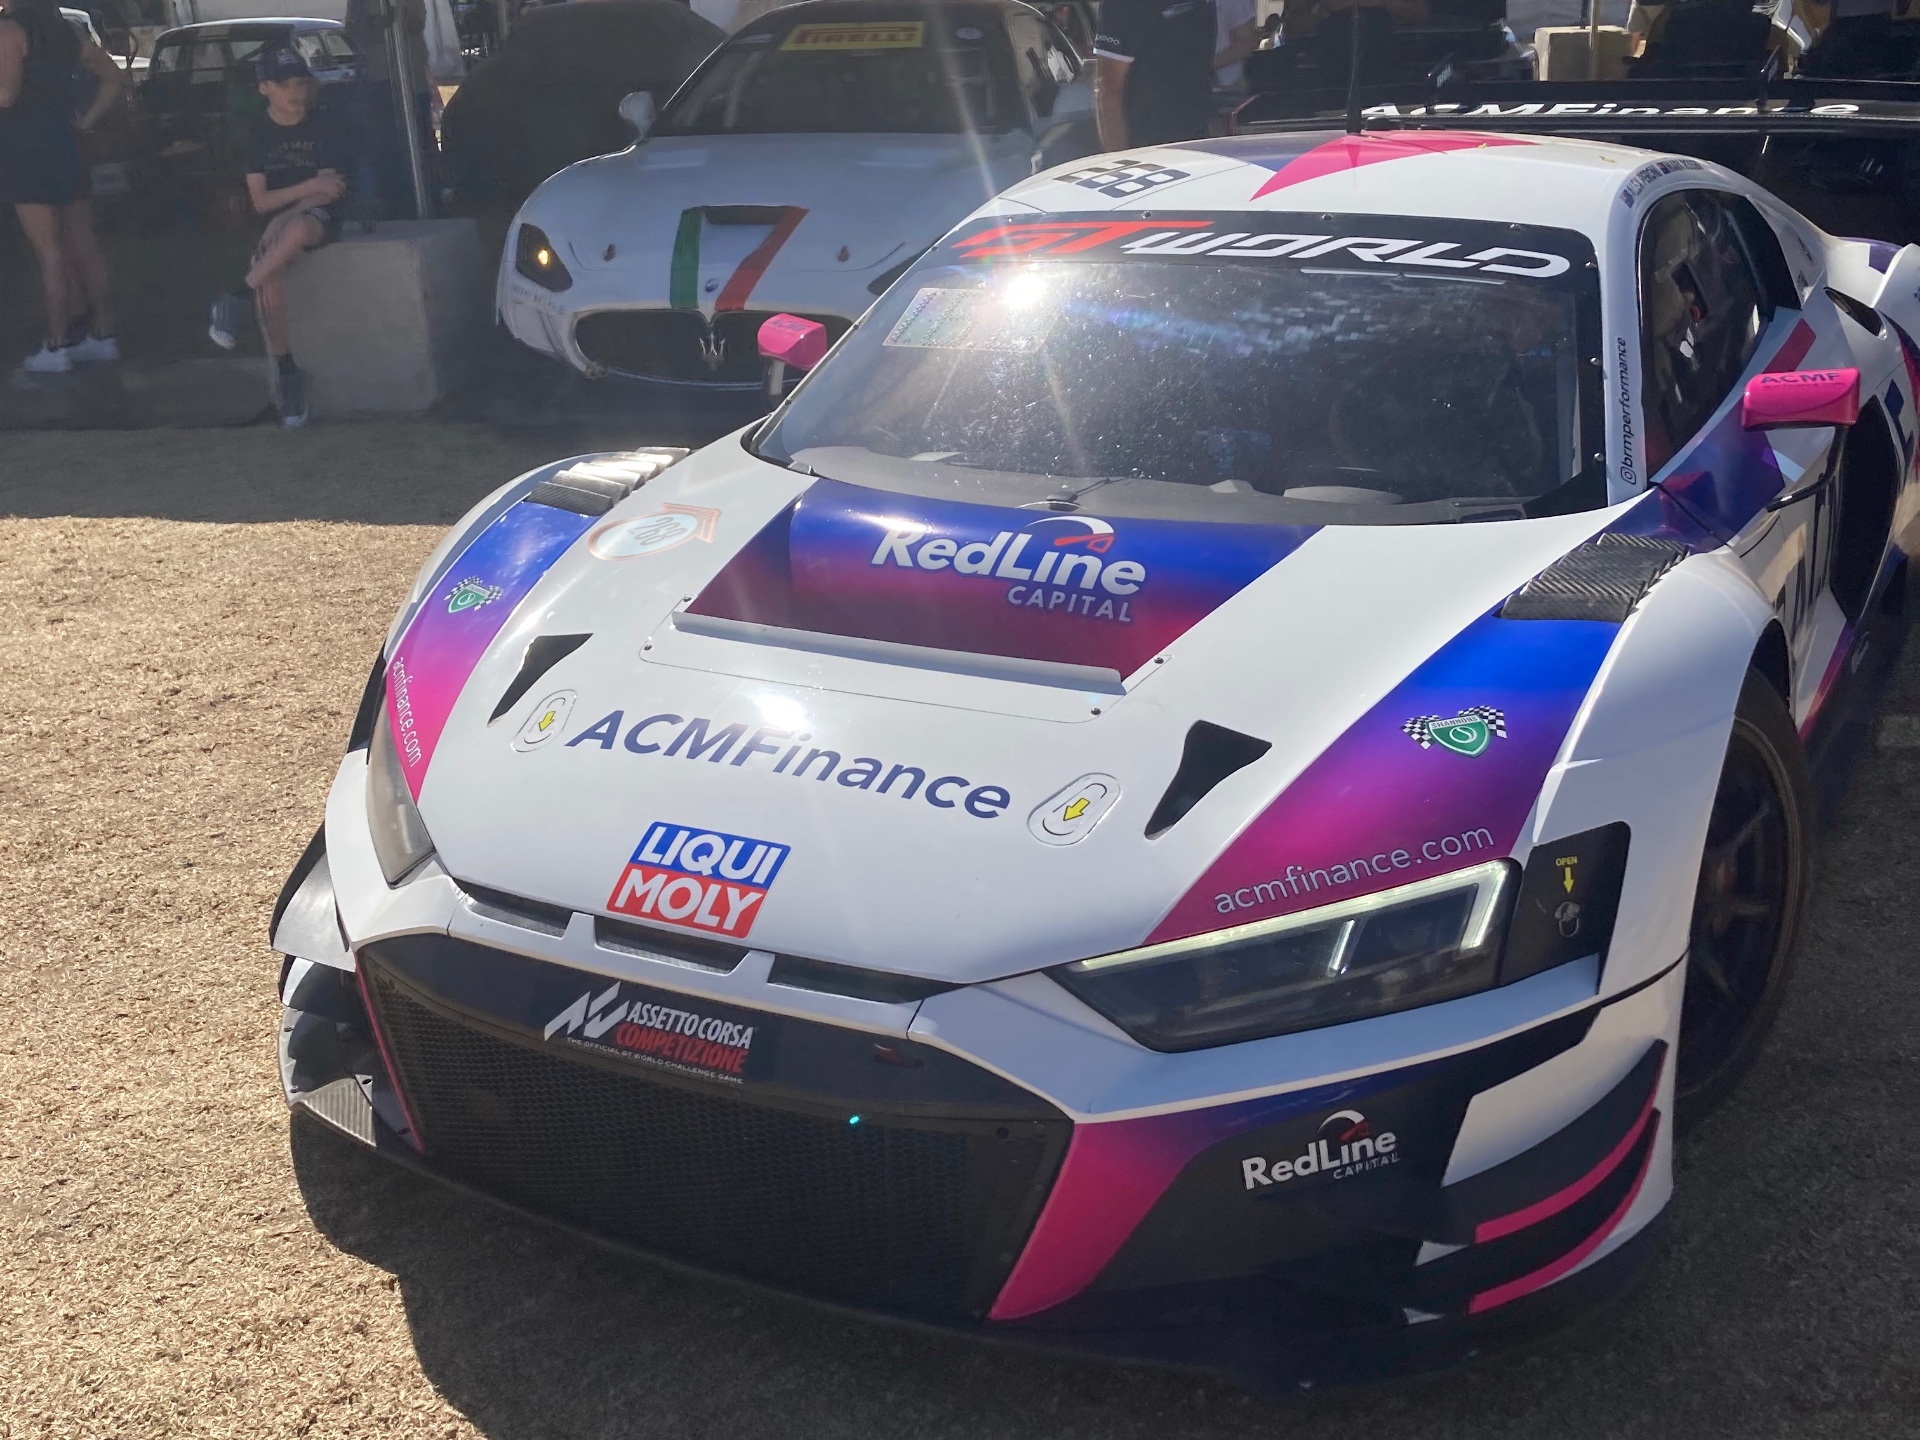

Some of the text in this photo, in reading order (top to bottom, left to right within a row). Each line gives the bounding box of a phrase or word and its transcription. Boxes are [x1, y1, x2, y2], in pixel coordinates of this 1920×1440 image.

[792, 26, 919, 44] PIRELLI
[1052, 159, 1191, 198] 268
[952, 221, 1570, 278] GT WORLD
[1761, 372, 1840, 384] ACMF
[627, 516, 689, 546] 268
[871, 530, 1146, 595] RedLine
[1008, 586, 1132, 622] CAPITAL
[392, 656, 422, 768] acmfinance.com
[565, 709, 1011, 819] ACMFinance
[638, 826, 782, 884] LIQUI
[1214, 827, 1494, 914] acmfinance.com
[1555, 856, 1578, 866] OPEN
[614, 868, 763, 931] MOLY
[615, 1022, 749, 1073] COMPETIZIONE
[626, 1001, 754, 1049] ASSETTO CORSA
[717, 1073, 744, 1085] GAME
[1242, 1132, 1397, 1190] RedLine
[1333, 1153, 1400, 1180] CAPITAL
